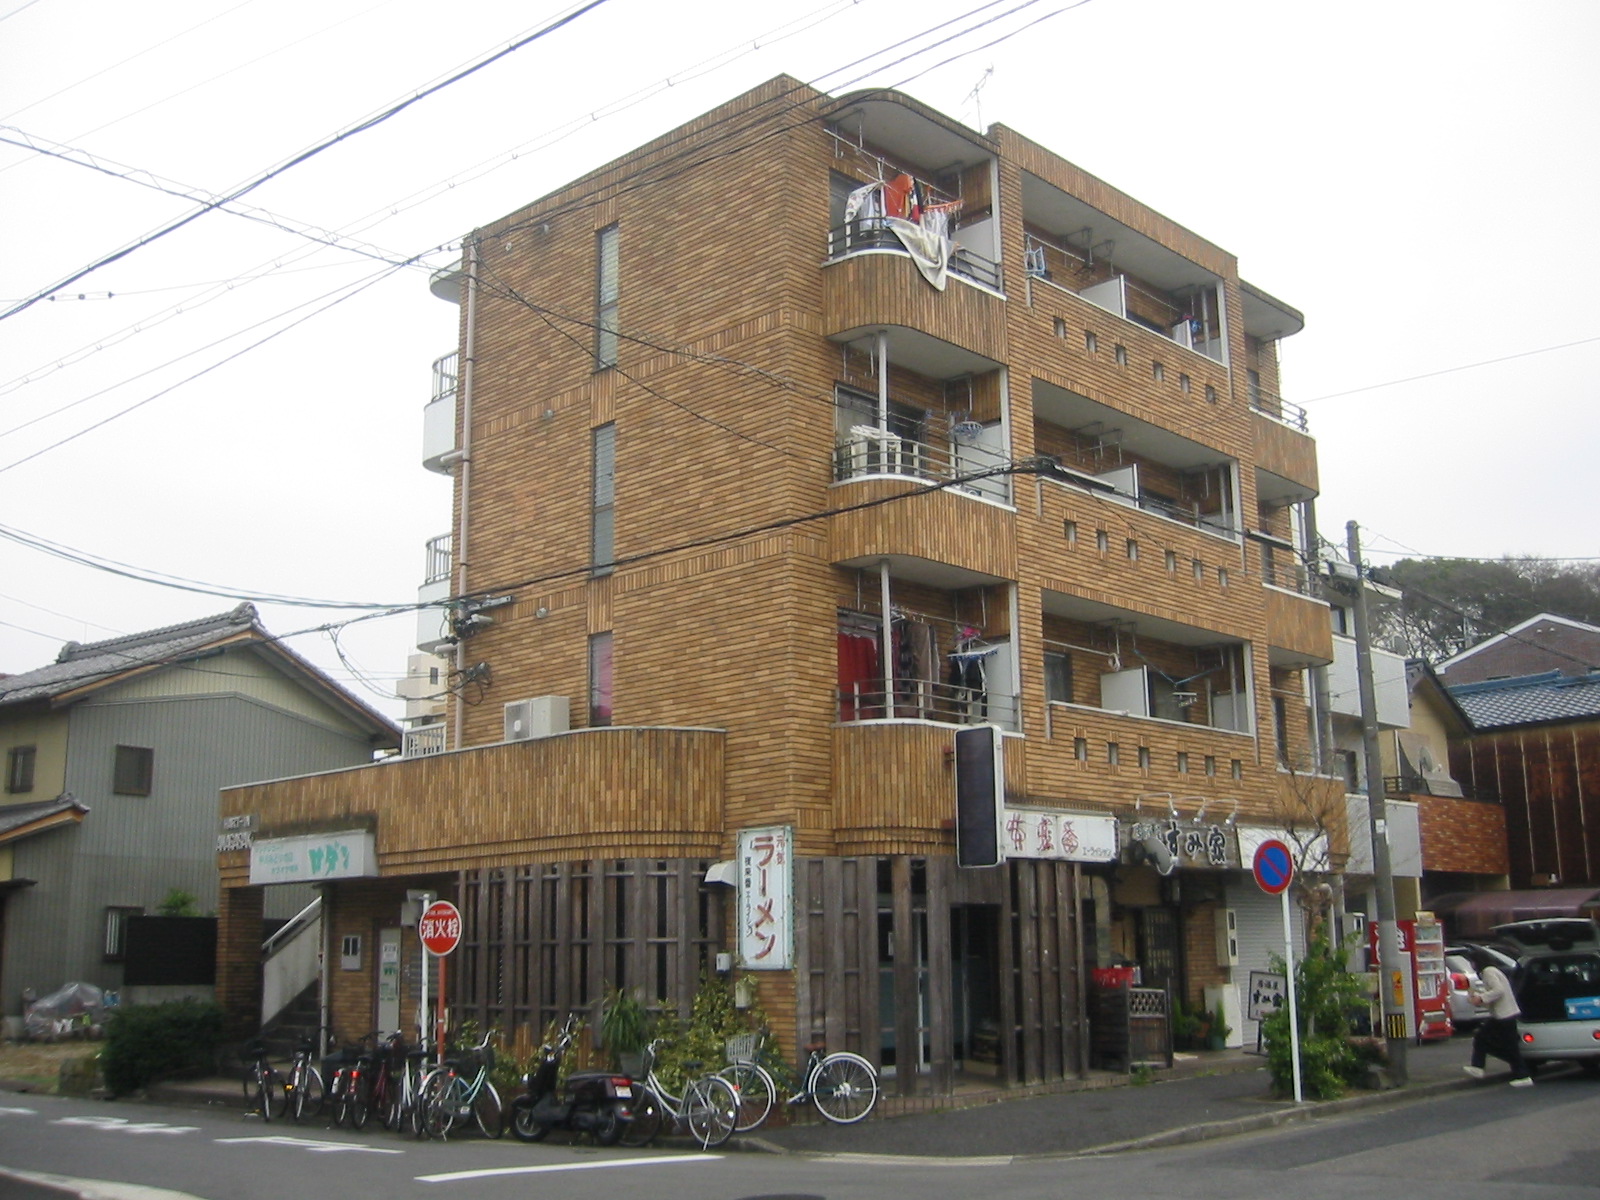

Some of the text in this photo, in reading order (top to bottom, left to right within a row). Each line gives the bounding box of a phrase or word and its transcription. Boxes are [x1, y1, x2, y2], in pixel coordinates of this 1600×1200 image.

[422, 918, 459, 939] 消火栓
[753, 835, 775, 960] ラーメン
